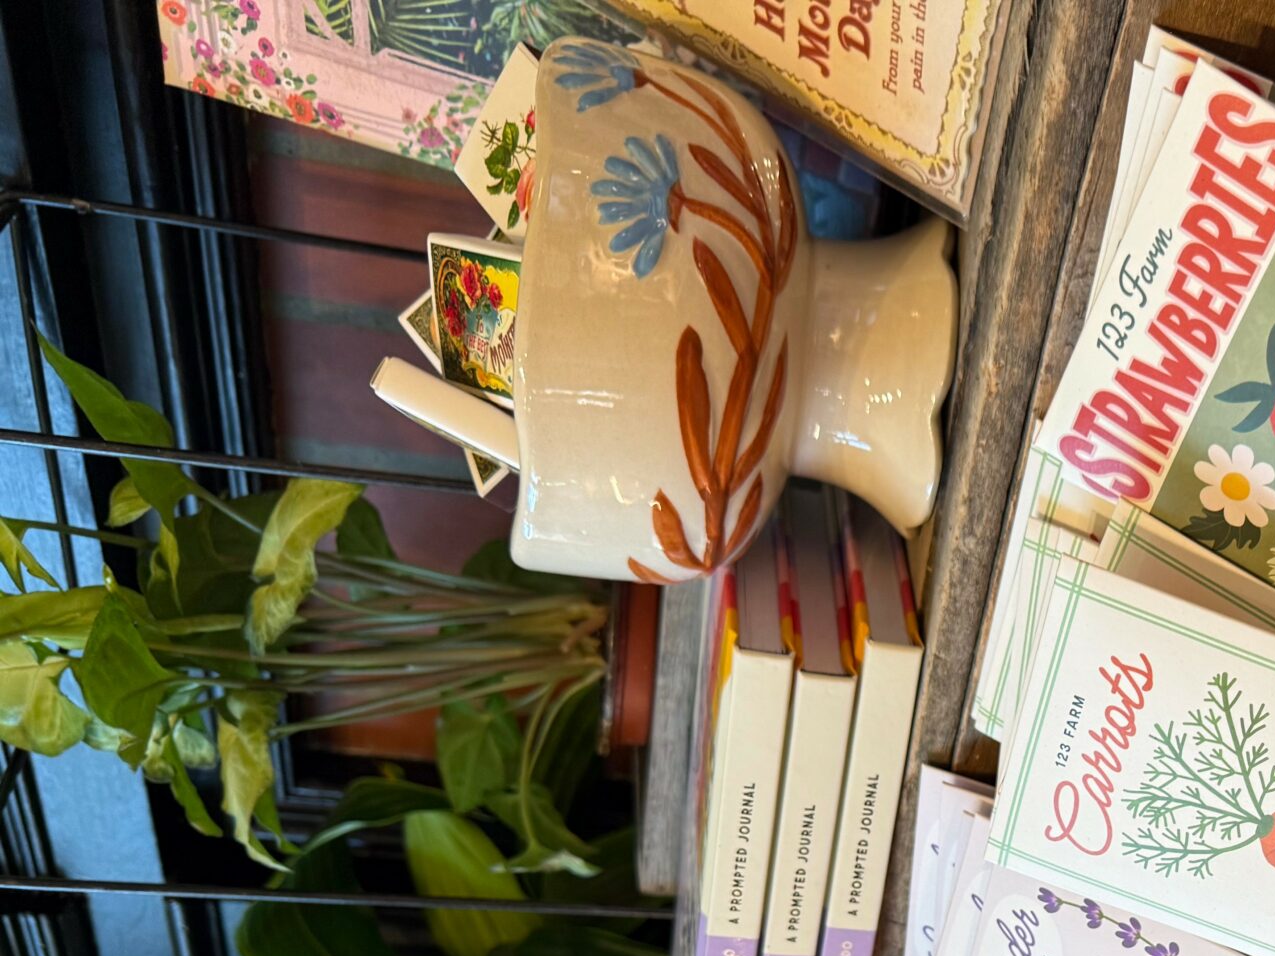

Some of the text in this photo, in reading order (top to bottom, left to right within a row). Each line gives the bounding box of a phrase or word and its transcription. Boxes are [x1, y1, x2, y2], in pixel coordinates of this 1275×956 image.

[754, 0, 786, 42] H
[798, 0, 831, 78] Mo
[882, 1, 904, 96] From your
[912, 28, 926, 47] in
[911, 51, 926, 94] pain
[1096, 227, 1174, 361] 123 Farm
[1044, 653, 1154, 856] Carrots
[1056, 694, 1086, 768] 123 FARM
[738, 782, 756, 842] JOURNAL
[797, 804, 816, 863] JOURNAL
[849, 839, 869, 904] PROMPTED
[860, 774, 880, 834] JOURNAL
[730, 847, 748, 912] PROMPTED
[788, 868, 807, 931] PROMPTED
